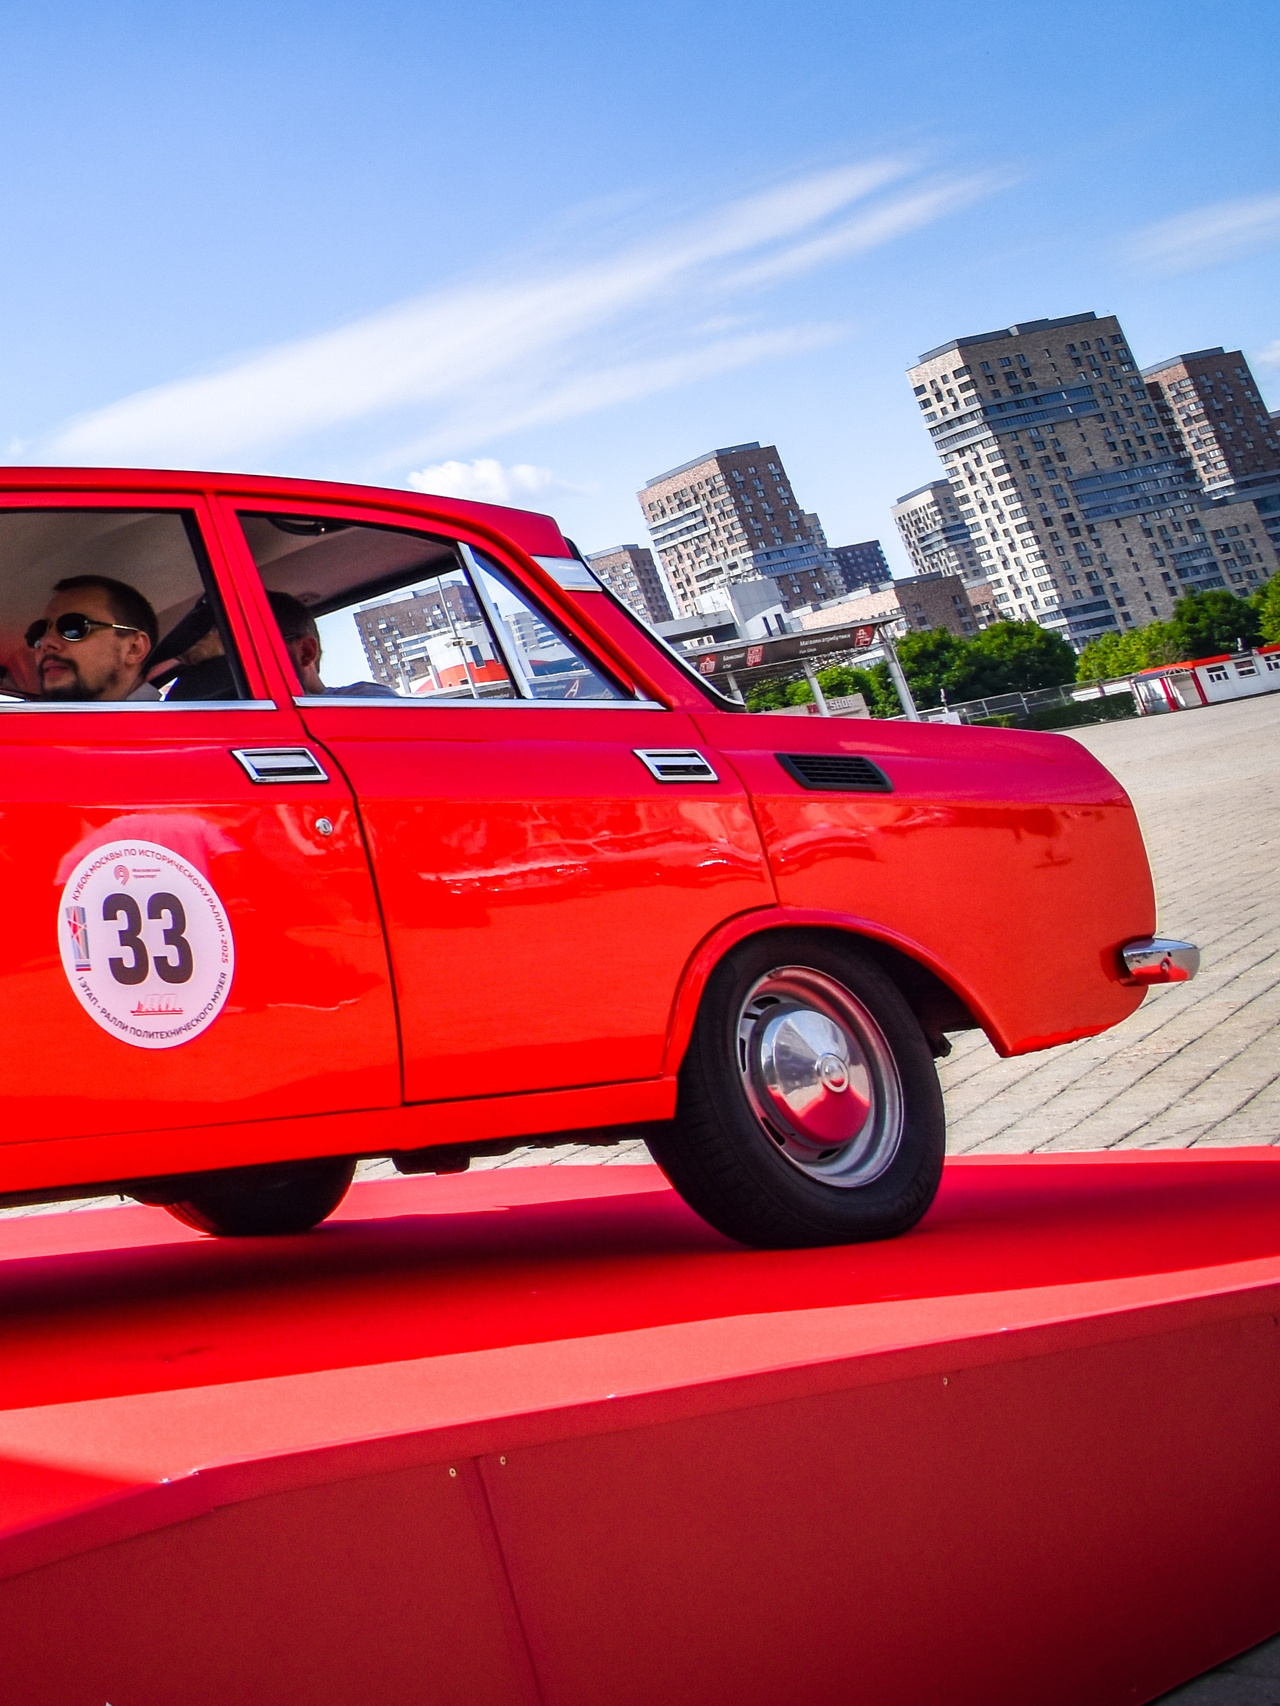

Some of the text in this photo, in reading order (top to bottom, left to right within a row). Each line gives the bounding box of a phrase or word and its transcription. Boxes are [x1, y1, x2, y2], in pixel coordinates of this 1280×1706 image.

[830, 698, 852, 710] SHOP
[72, 848, 229, 964] КУБОК МОСКВЫ ПО ИСТОРИЧЕСКОМУ РАЛЛИ 2025
[102, 892, 194, 986] 33
[80, 981, 98, 1005] ЭТАП
[100, 1008, 128, 1031] РАЛЛИ
[129, 1003, 213, 1039] ПОЛИТЕХНИЧЕСКОГО
[211, 972, 227, 1003] МУЗЕЯ
